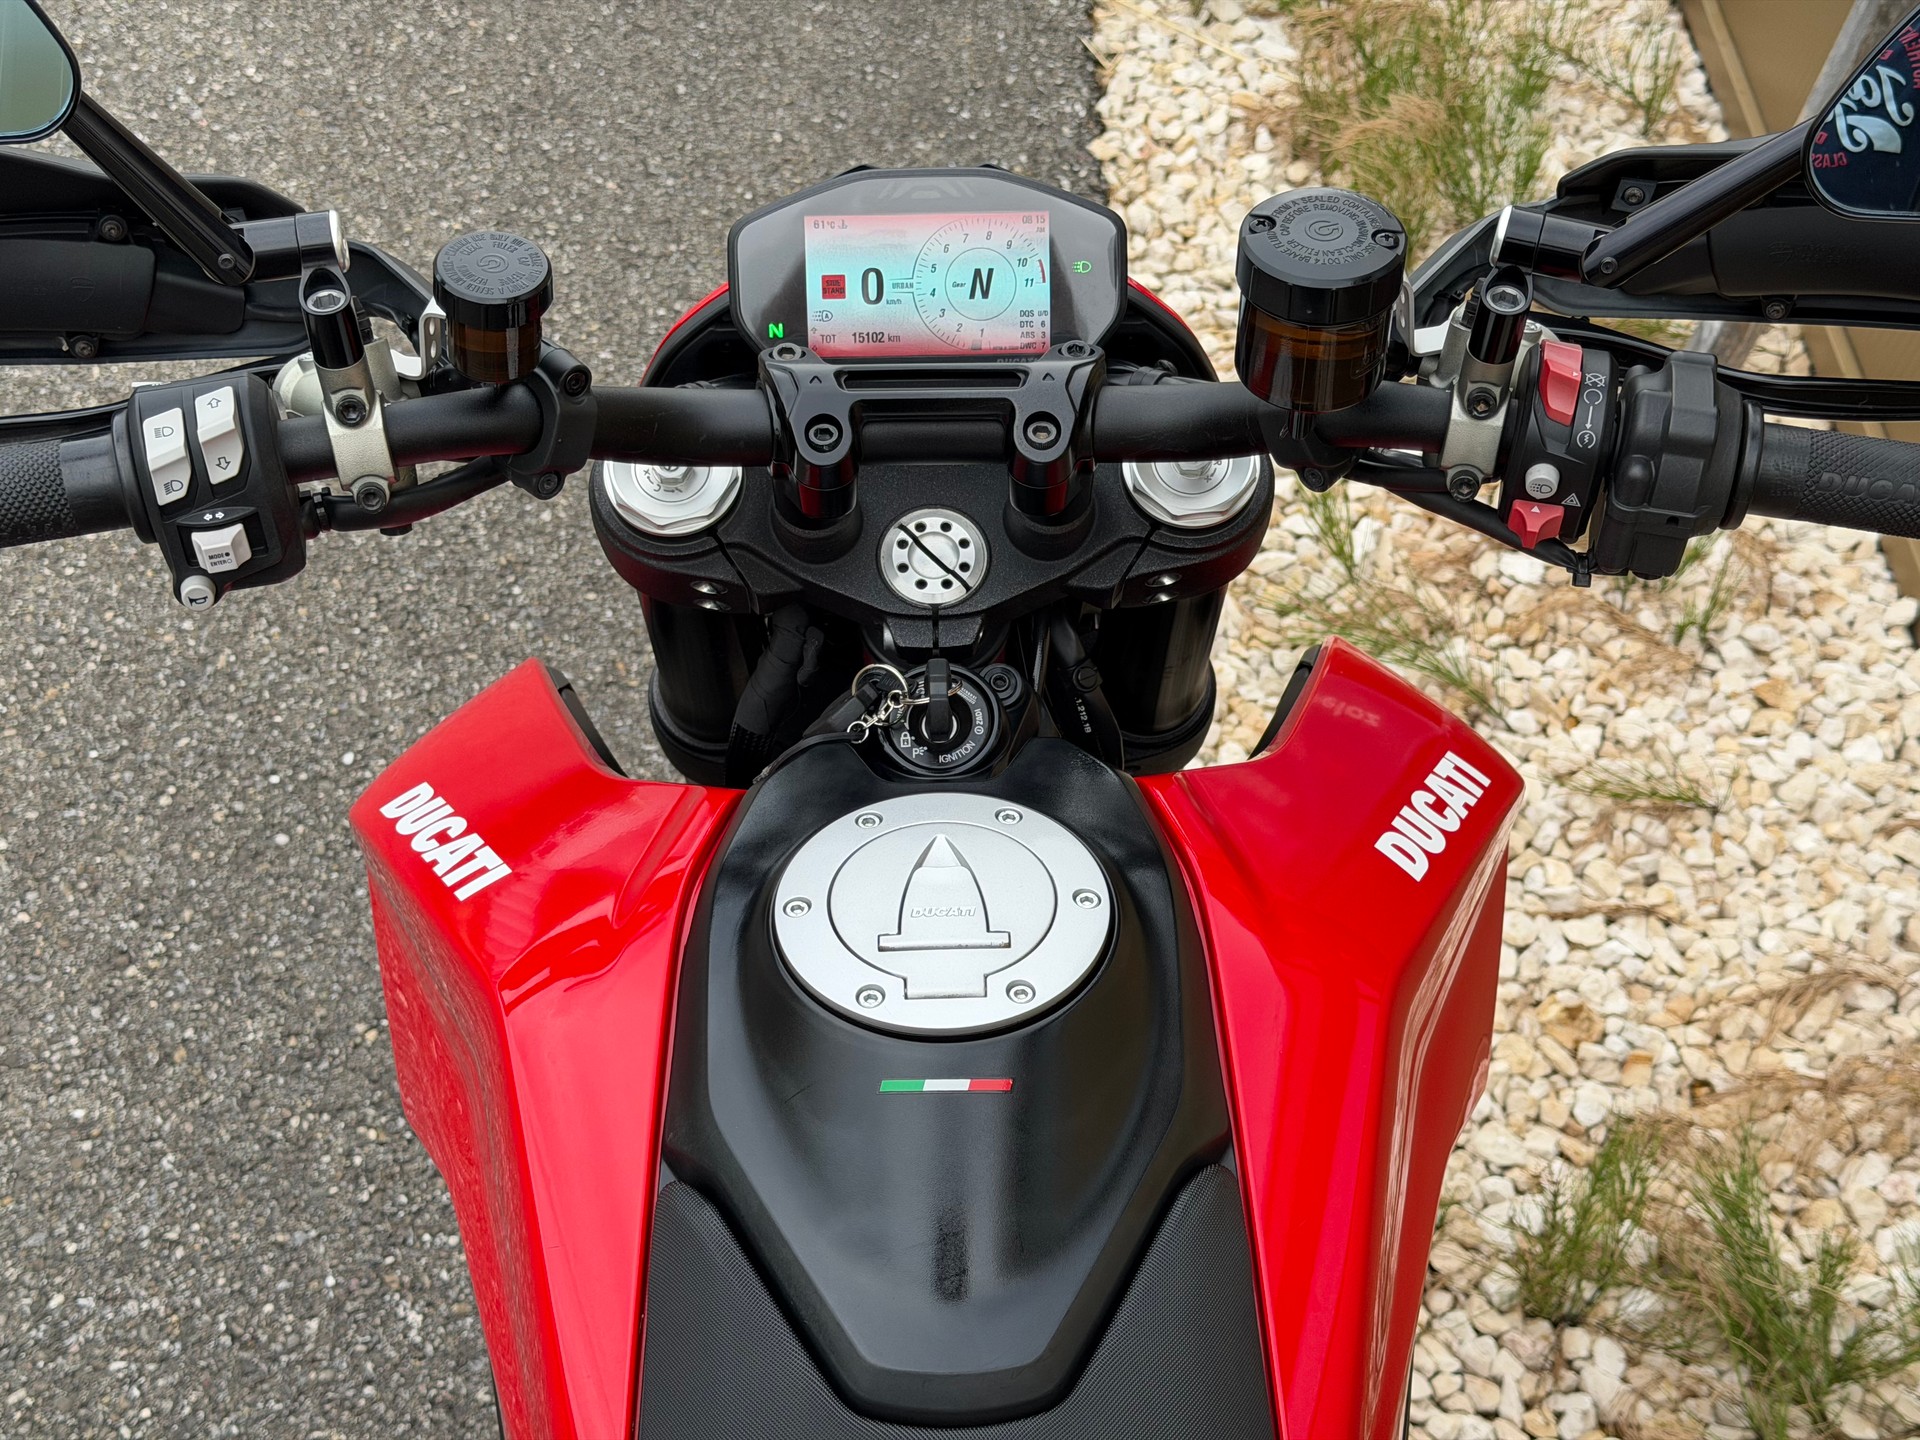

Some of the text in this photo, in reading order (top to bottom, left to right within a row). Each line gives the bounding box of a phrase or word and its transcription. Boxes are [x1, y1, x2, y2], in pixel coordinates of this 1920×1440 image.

[1301, 196, 1340, 204] SEALED
[1282, 205, 1311, 224] BEFORE
[963, 233, 969, 243] 7
[986, 231, 993, 240] 8
[943, 244, 950, 253] 6
[1006, 240, 1013, 249] 9
[1287, 239, 1320, 256] FILLER
[1281, 247, 1311, 264] BRAKE
[1343, 251, 1365, 264] ONLY
[1017, 257, 1028, 267] 10
[930, 263, 937, 273] 5
[861, 266, 884, 305] 0
[969, 267, 994, 300] N
[1024, 278, 1034, 288] 11
[930, 288, 936, 298] 4
[939, 308, 946, 318] 3
[956, 323, 963, 333] 2
[1041, 320, 1046, 328] 6
[820, 331, 901, 343] TOT 15102 km
[1020, 331, 1046, 339] ABS 3
[1020, 342, 1037, 350] DWC
[1041, 342, 1046, 350] 7
[208, 552, 224, 560] MODE
[210, 559, 227, 567] ENTER
[974, 708, 983, 725] ZADI
[939, 740, 976, 763] IGNITION
[1374, 750, 1492, 882] DUCATI
[379, 781, 513, 902] DUCATI
[911, 907, 976, 918] DUCATI
